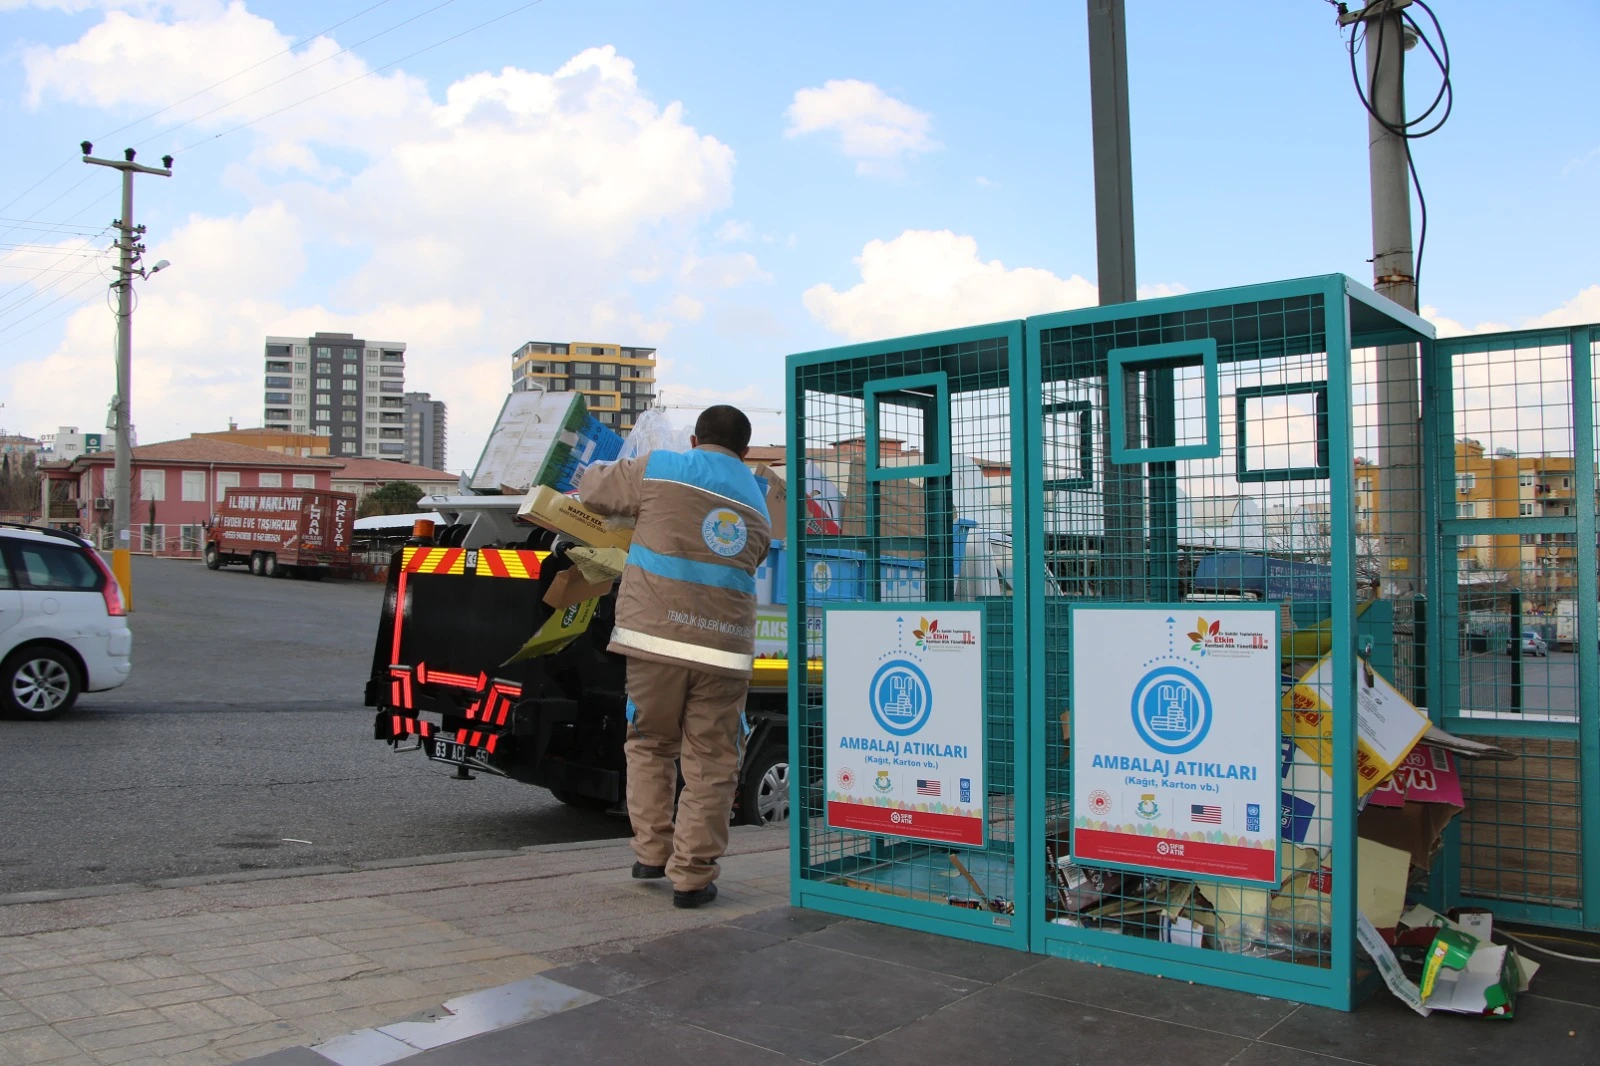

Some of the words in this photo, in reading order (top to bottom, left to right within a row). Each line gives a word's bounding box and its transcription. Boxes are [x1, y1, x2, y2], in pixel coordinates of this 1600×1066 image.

[243, 517, 255, 528] EVE
[667, 609, 698, 627] TEMİZLİK
[697, 615, 720, 631] İŞLERİ
[435, 741, 447, 758] 63
[839, 736, 900, 757] AMBALAJ
[903, 741, 968, 759] ATIKLARI
[864, 755, 891, 766] (Kağıt,
[893, 758, 921, 767] Karton
[923, 761, 939, 770] vb.)
[1091, 754, 1170, 778] AMBALAJ
[1174, 760, 1257, 781] ATIKLARI
[1124, 775, 1158, 788] (Kağıt,
[1161, 779, 1197, 790] Karton
[1199, 782, 1220, 794] vb.)
